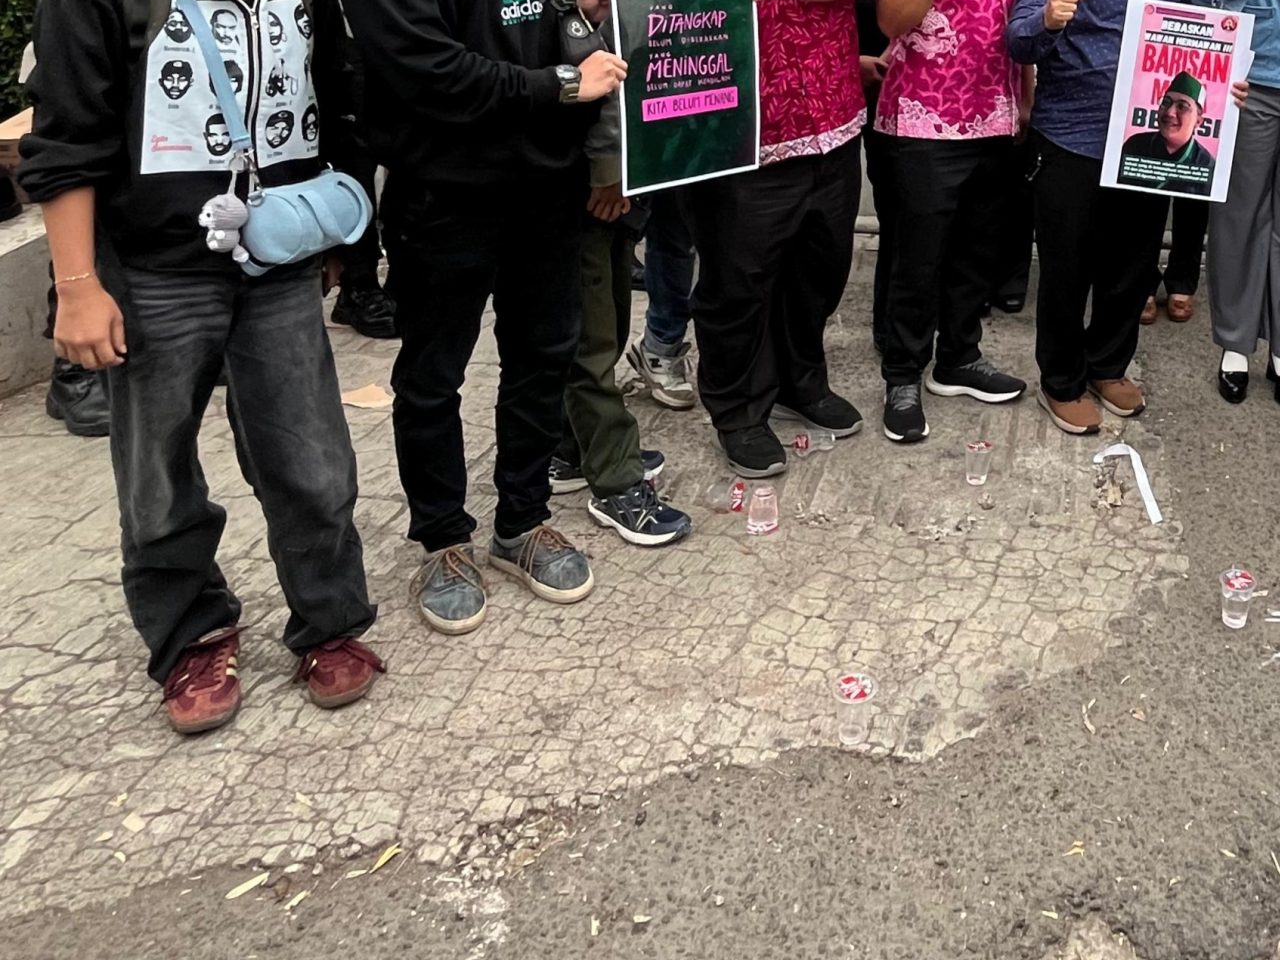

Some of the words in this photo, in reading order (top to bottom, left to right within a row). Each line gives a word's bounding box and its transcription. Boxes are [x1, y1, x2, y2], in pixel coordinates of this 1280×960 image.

[1161, 19, 1214, 38] BEBASKAN
[648, 38, 673, 48] BELUM
[1141, 43, 1232, 84] BARISAN
[646, 82, 669, 93] BELUM
[647, 101, 668, 116] KITA
[672, 96, 701, 112] BELUM
[704, 90, 736, 107] MENANG
